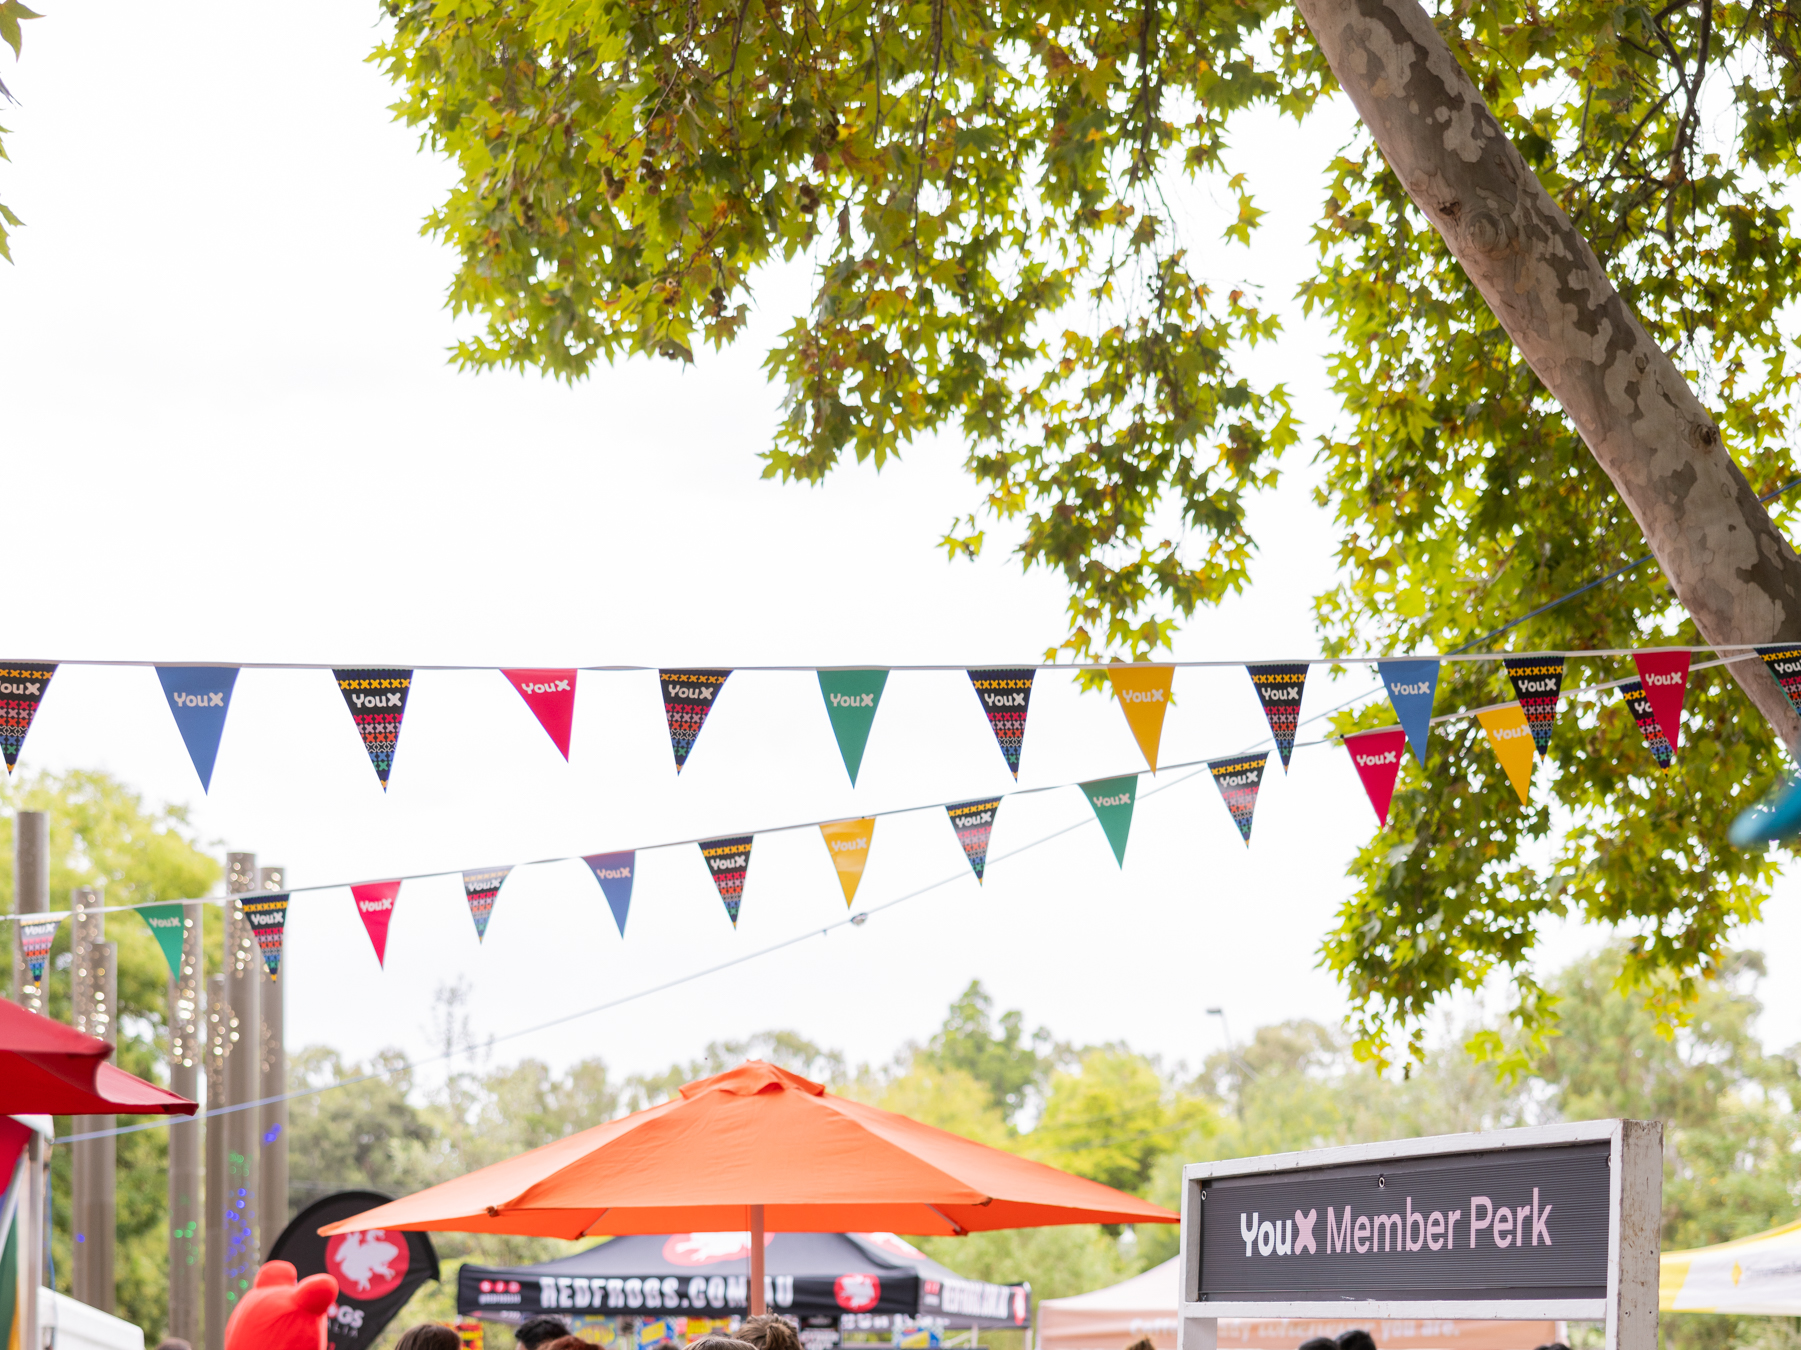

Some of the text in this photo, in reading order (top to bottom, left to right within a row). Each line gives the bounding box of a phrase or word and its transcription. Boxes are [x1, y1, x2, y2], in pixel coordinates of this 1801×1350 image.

[1774, 659, 1801, 675] You
[522, 679, 571, 694] YouX
[1518, 678, 1557, 693] YouX
[1645, 671, 1682, 687] YouX
[0, 680, 41, 696] ouX
[668, 684, 713, 700] YouX
[1122, 688, 1164, 703] YouX
[1261, 686, 1299, 701] YouX
[1391, 681, 1430, 696] YouX
[173, 692, 224, 708] YouX
[352, 692, 402, 708] YouX
[830, 693, 874, 708] YouX
[984, 692, 1025, 708] YouX
[1634, 700, 1653, 714] Yo
[1493, 724, 1532, 741] YouX
[1356, 750, 1397, 767] YouX
[1219, 770, 1259, 788] YouX
[1093, 793, 1131, 808] YouX
[955, 811, 992, 828] YouX
[832, 837, 867, 852] YouX
[710, 855, 746, 870] YouX
[596, 867, 631, 880] YouX
[468, 878, 501, 893] YouX
[359, 898, 392, 912] YouX
[149, 916, 181, 929] YouX
[251, 911, 284, 926] YouX
[24, 922, 56, 936] YouX
[1240, 1186, 1553, 1258] YouX Member Perk
